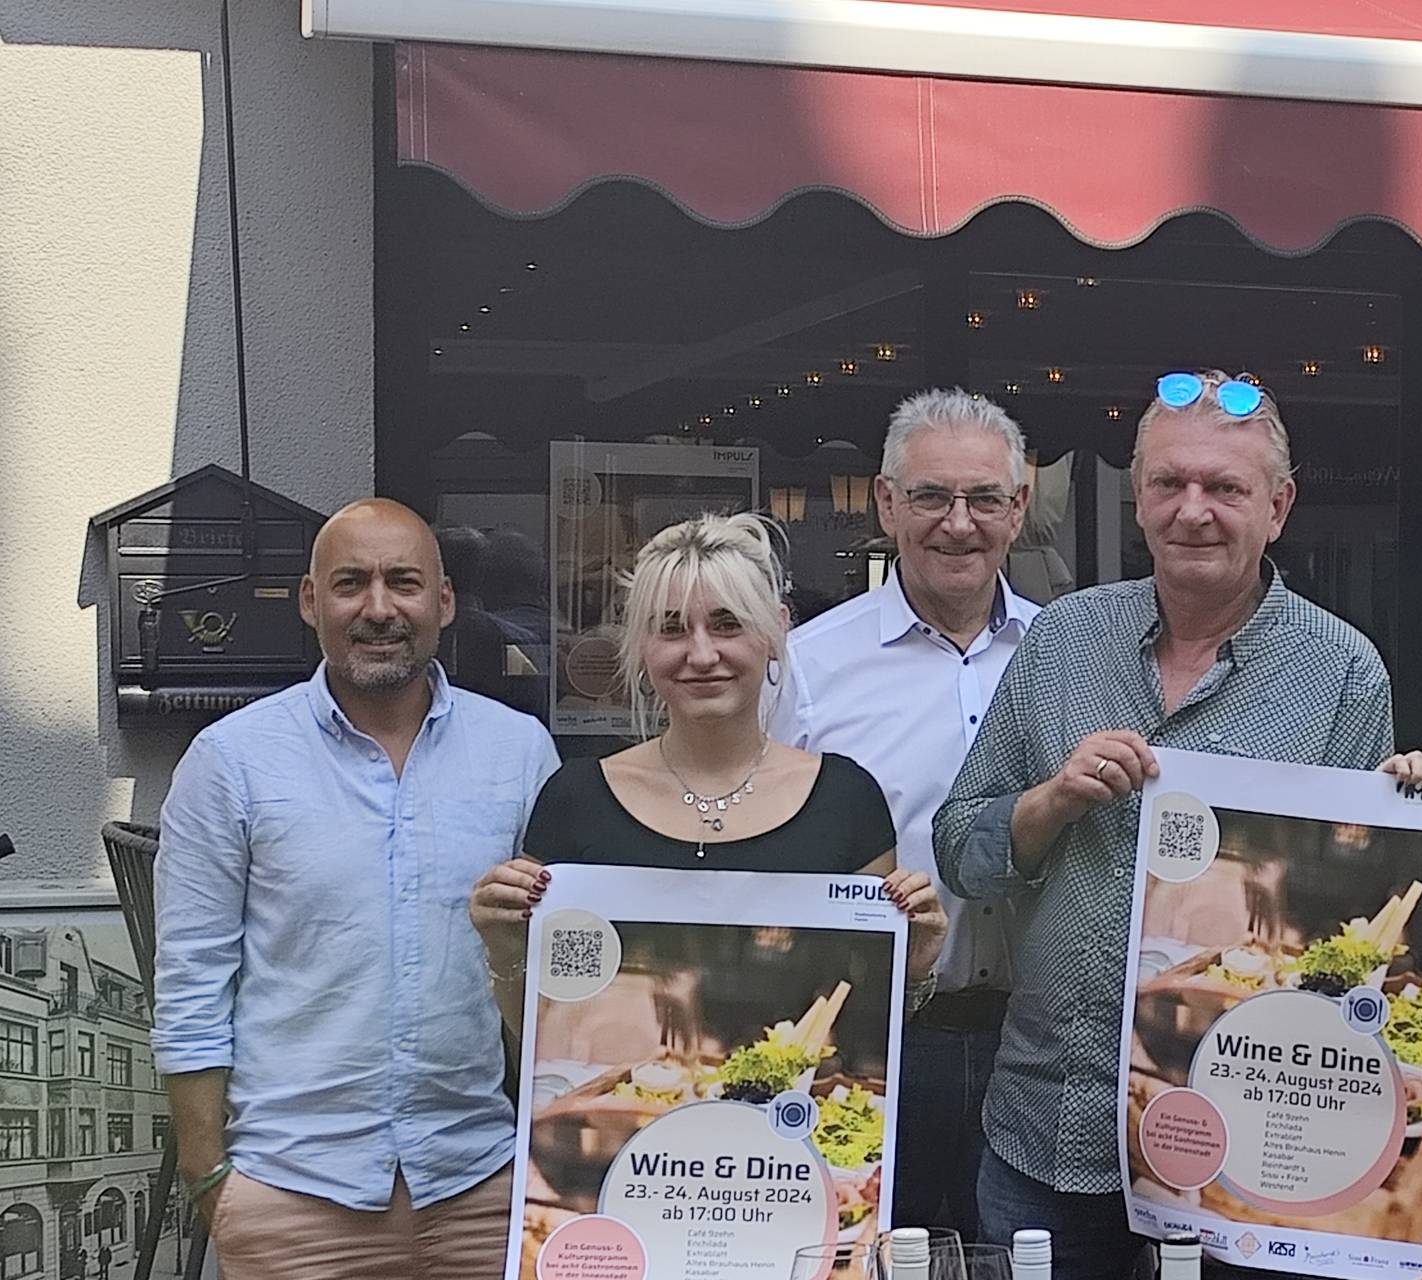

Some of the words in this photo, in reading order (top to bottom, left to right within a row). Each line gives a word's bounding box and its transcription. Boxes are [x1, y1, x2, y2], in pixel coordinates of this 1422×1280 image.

[713, 451, 753, 461] IMPULS
[1216, 1033, 1283, 1063] Wine
[1291, 1044, 1312, 1066] &
[1321, 1047, 1381, 1075] Dine
[1245, 1067, 1271, 1083] 24.
[1275, 1071, 1334, 1090] August
[1338, 1078, 1383, 1096] 2024
[1243, 1086, 1263, 1101] ab
[1268, 1089, 1311, 1107] 17:00
[1316, 1095, 1346, 1111] Uhr
[630, 1152, 705, 1178] Wine
[714, 1156, 737, 1179] &
[746, 1156, 811, 1181] Dine
[664, 1185, 692, 1200] 24.
[697, 1186, 761, 1204] August
[765, 1188, 812, 1204] 2024
[661, 1205, 683, 1220] ab
[689, 1206, 736, 1222] 17:00
[742, 1208, 773, 1222] Uhr
